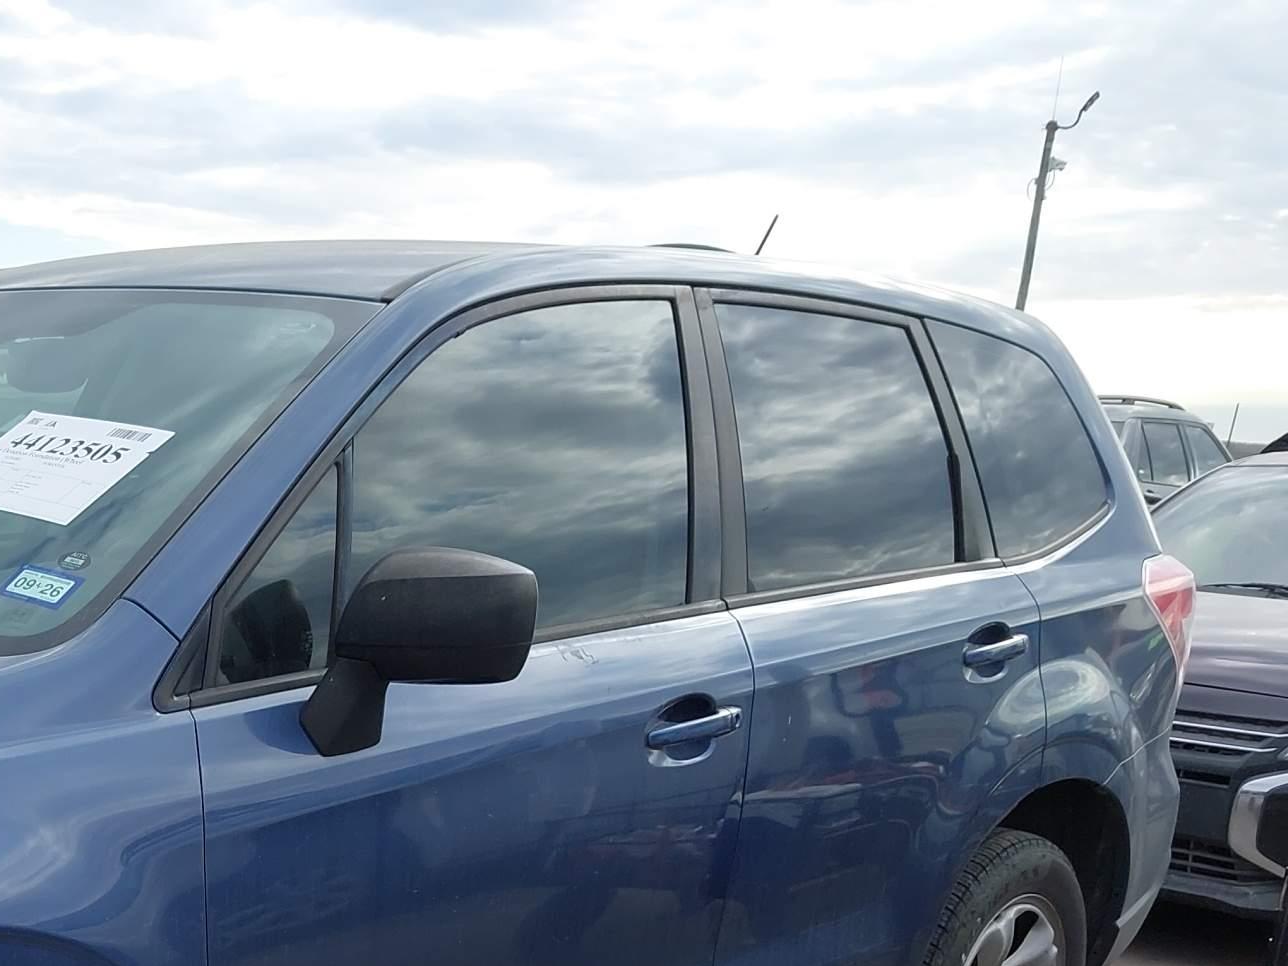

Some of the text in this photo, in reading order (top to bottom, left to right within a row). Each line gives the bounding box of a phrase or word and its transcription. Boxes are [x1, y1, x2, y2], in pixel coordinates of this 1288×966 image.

[10, 432, 131, 463] 44123505
[13, 576, 37, 590] 09
[38, 583, 65, 598] 26
